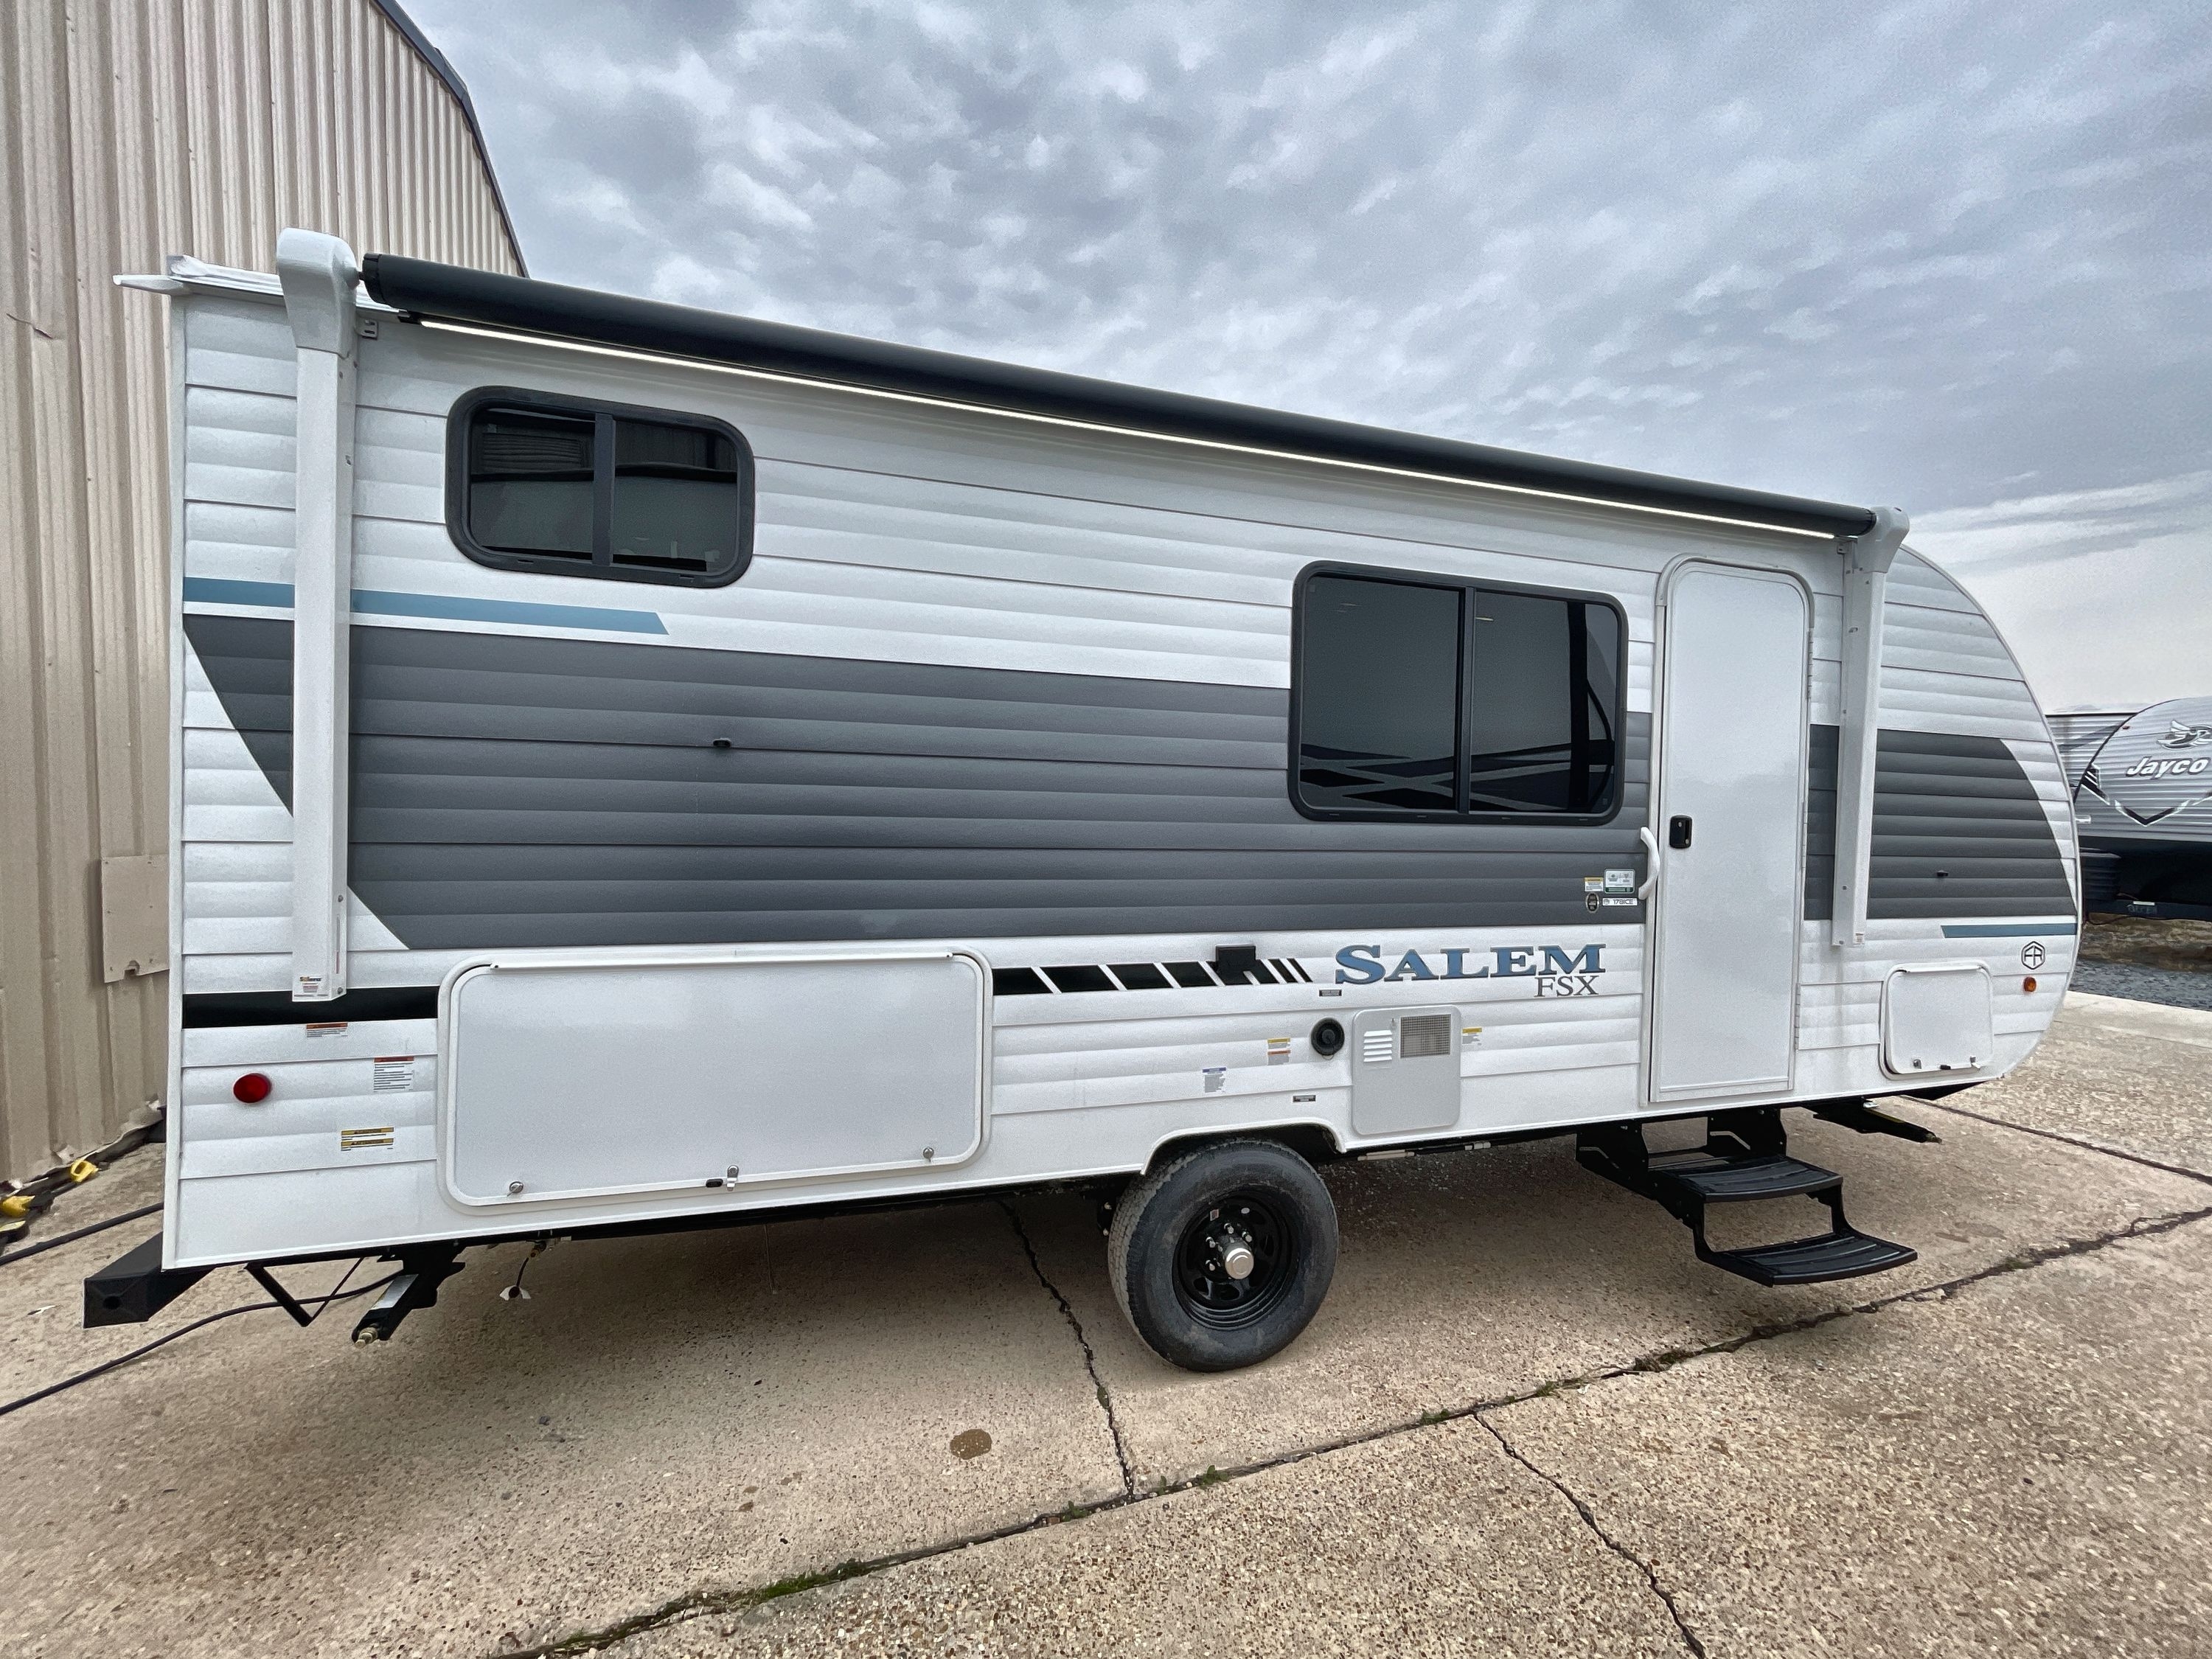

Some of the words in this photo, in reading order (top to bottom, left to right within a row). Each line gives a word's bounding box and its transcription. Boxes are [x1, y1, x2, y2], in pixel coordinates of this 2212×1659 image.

[2126, 756, 2211, 780] Jayco
[1335, 944, 1607, 985] SALEM
[1534, 975, 1599, 998] FSX
